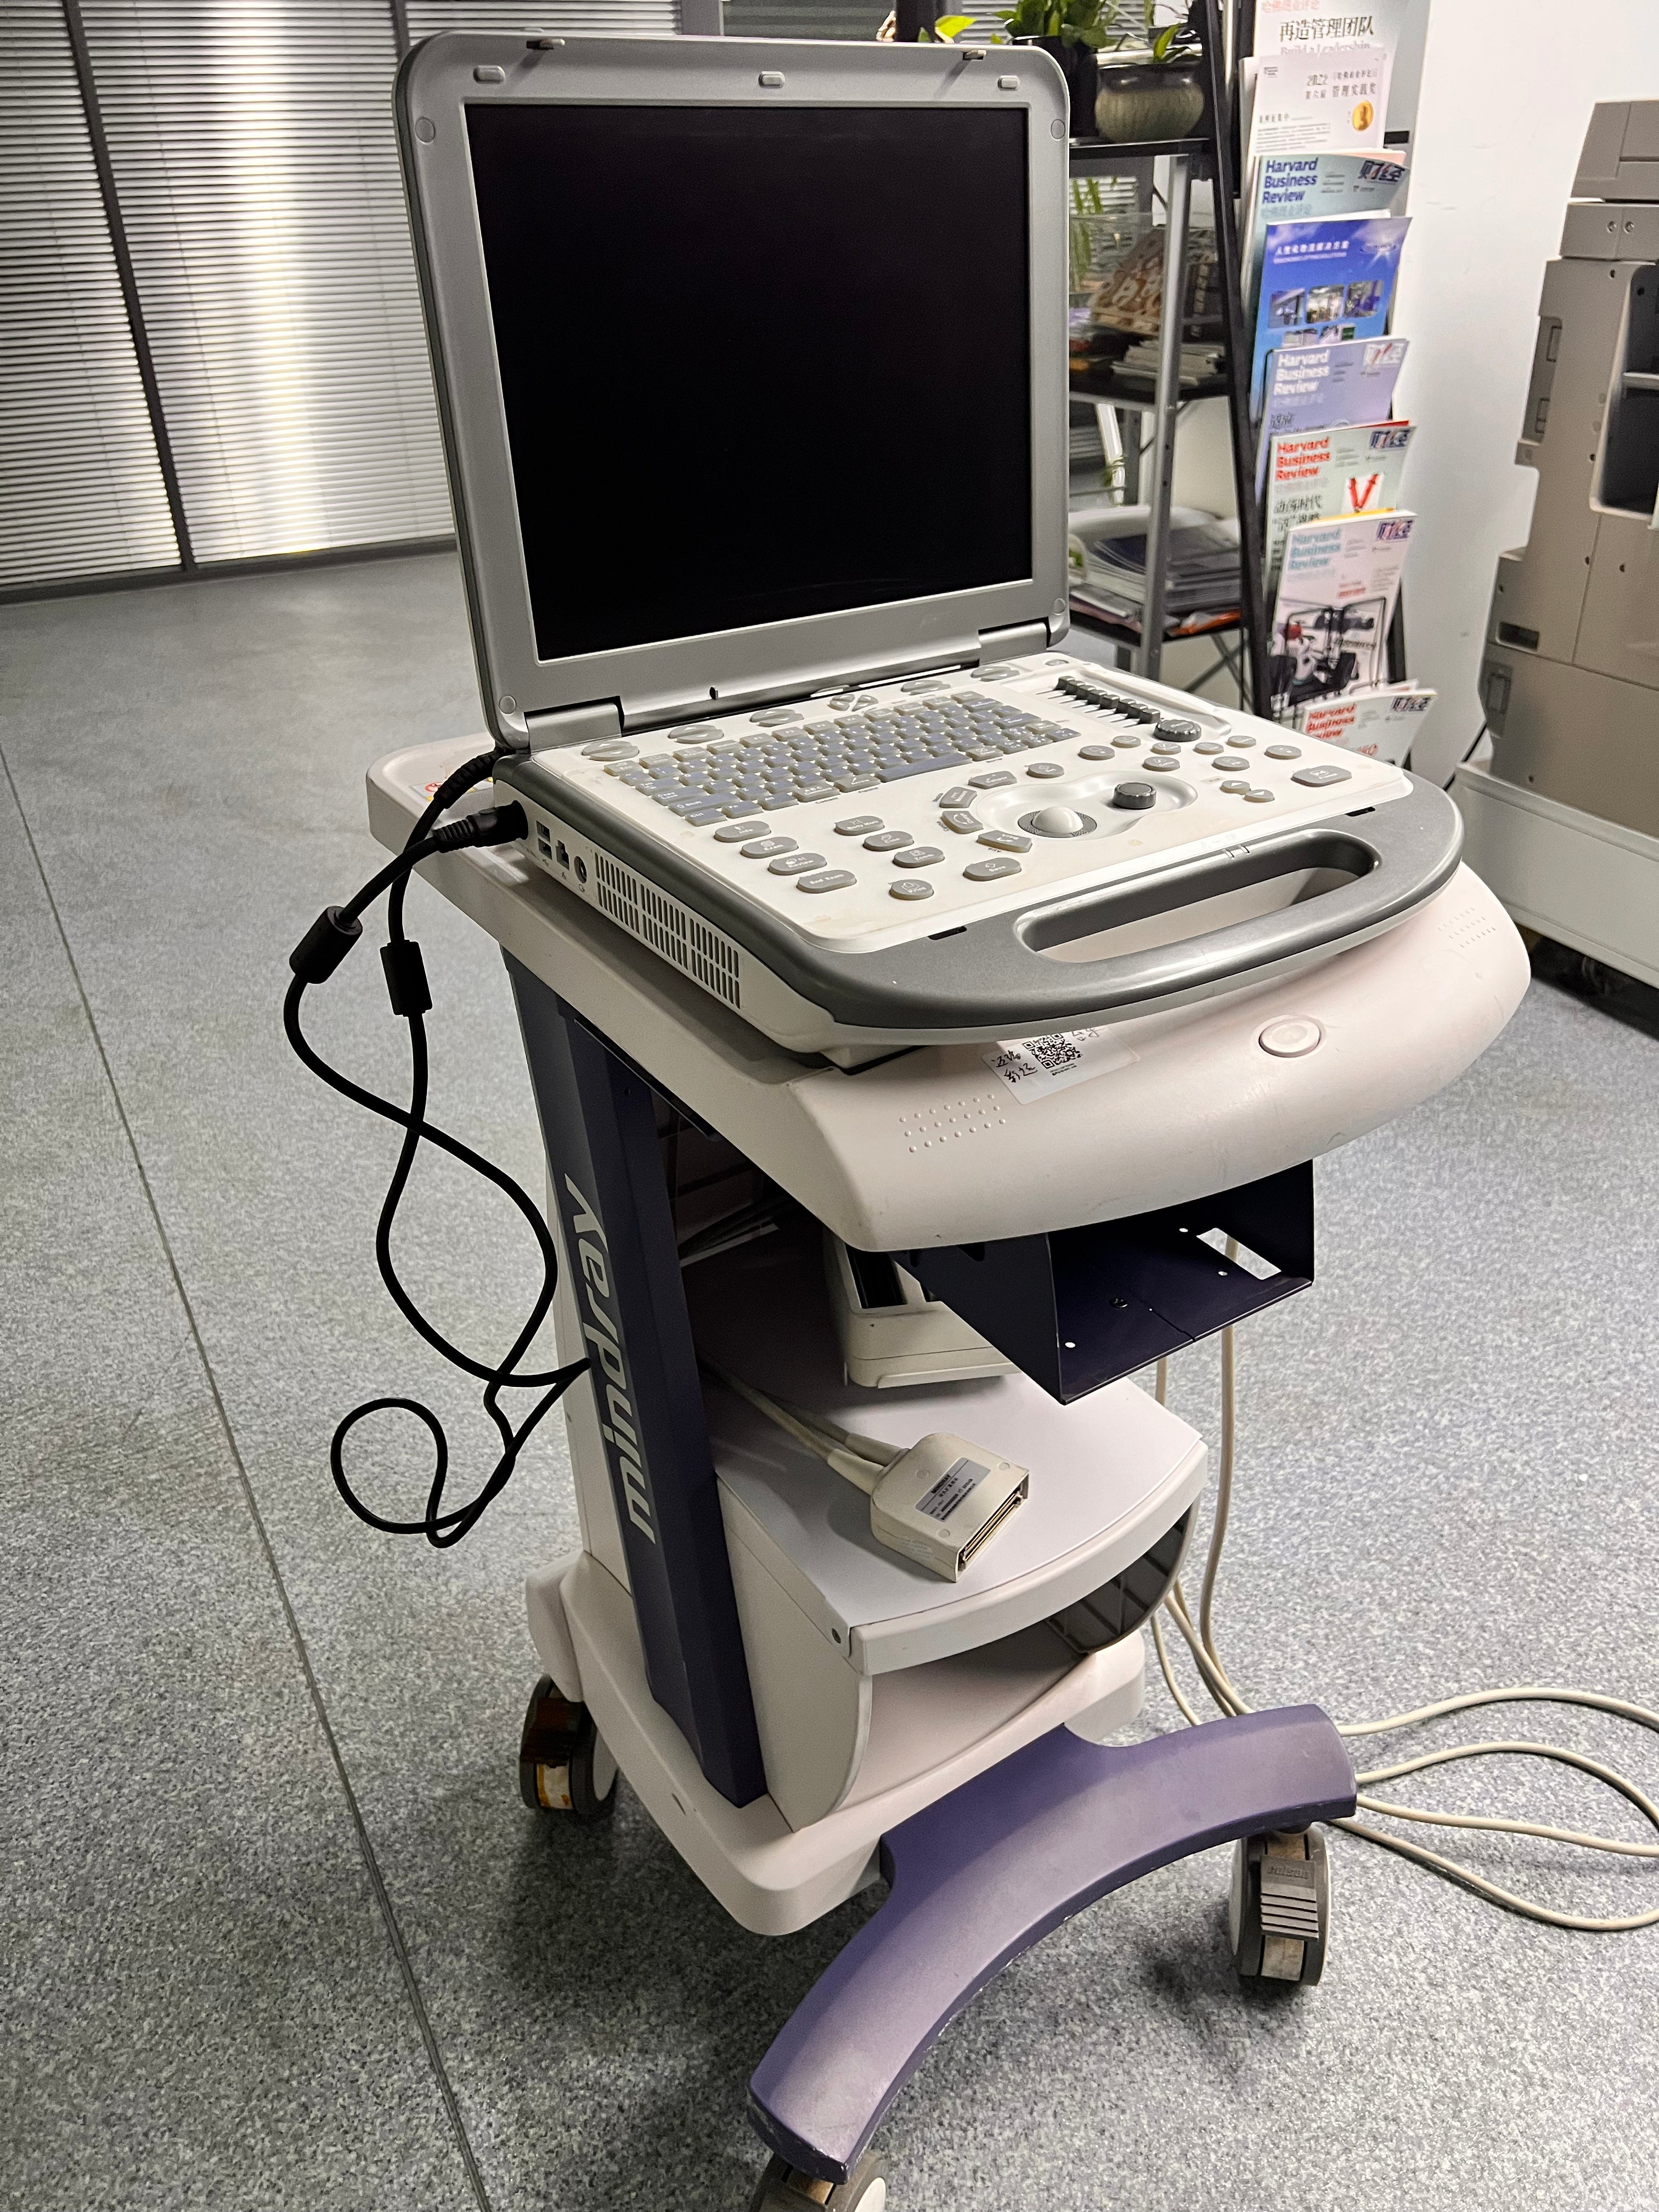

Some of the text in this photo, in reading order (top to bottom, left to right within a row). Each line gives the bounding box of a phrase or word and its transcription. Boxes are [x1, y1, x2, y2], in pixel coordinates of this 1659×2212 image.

[1279, 16, 1374, 42] 再造管理团队
[1266, 157, 1318, 173] Harvard
[1264, 174, 1318, 189] Business
[1262, 189, 1305, 204] Review
[1278, 349, 1330, 367] Harvard
[1276, 366, 1330, 381] Business
[1274, 381, 1319, 395] Review
[1277, 437, 1330, 453] Harvard
[1277, 453, 1330, 467] Business
[1276, 467, 1320, 481] Review
[1293, 527, 1341, 544] Harvard
[1310, 702, 1356, 719] Harvard
[1307, 716, 1355, 733] Business
[1314, 727, 1342, 739] view
[565, 1173, 656, 1545] mindray
